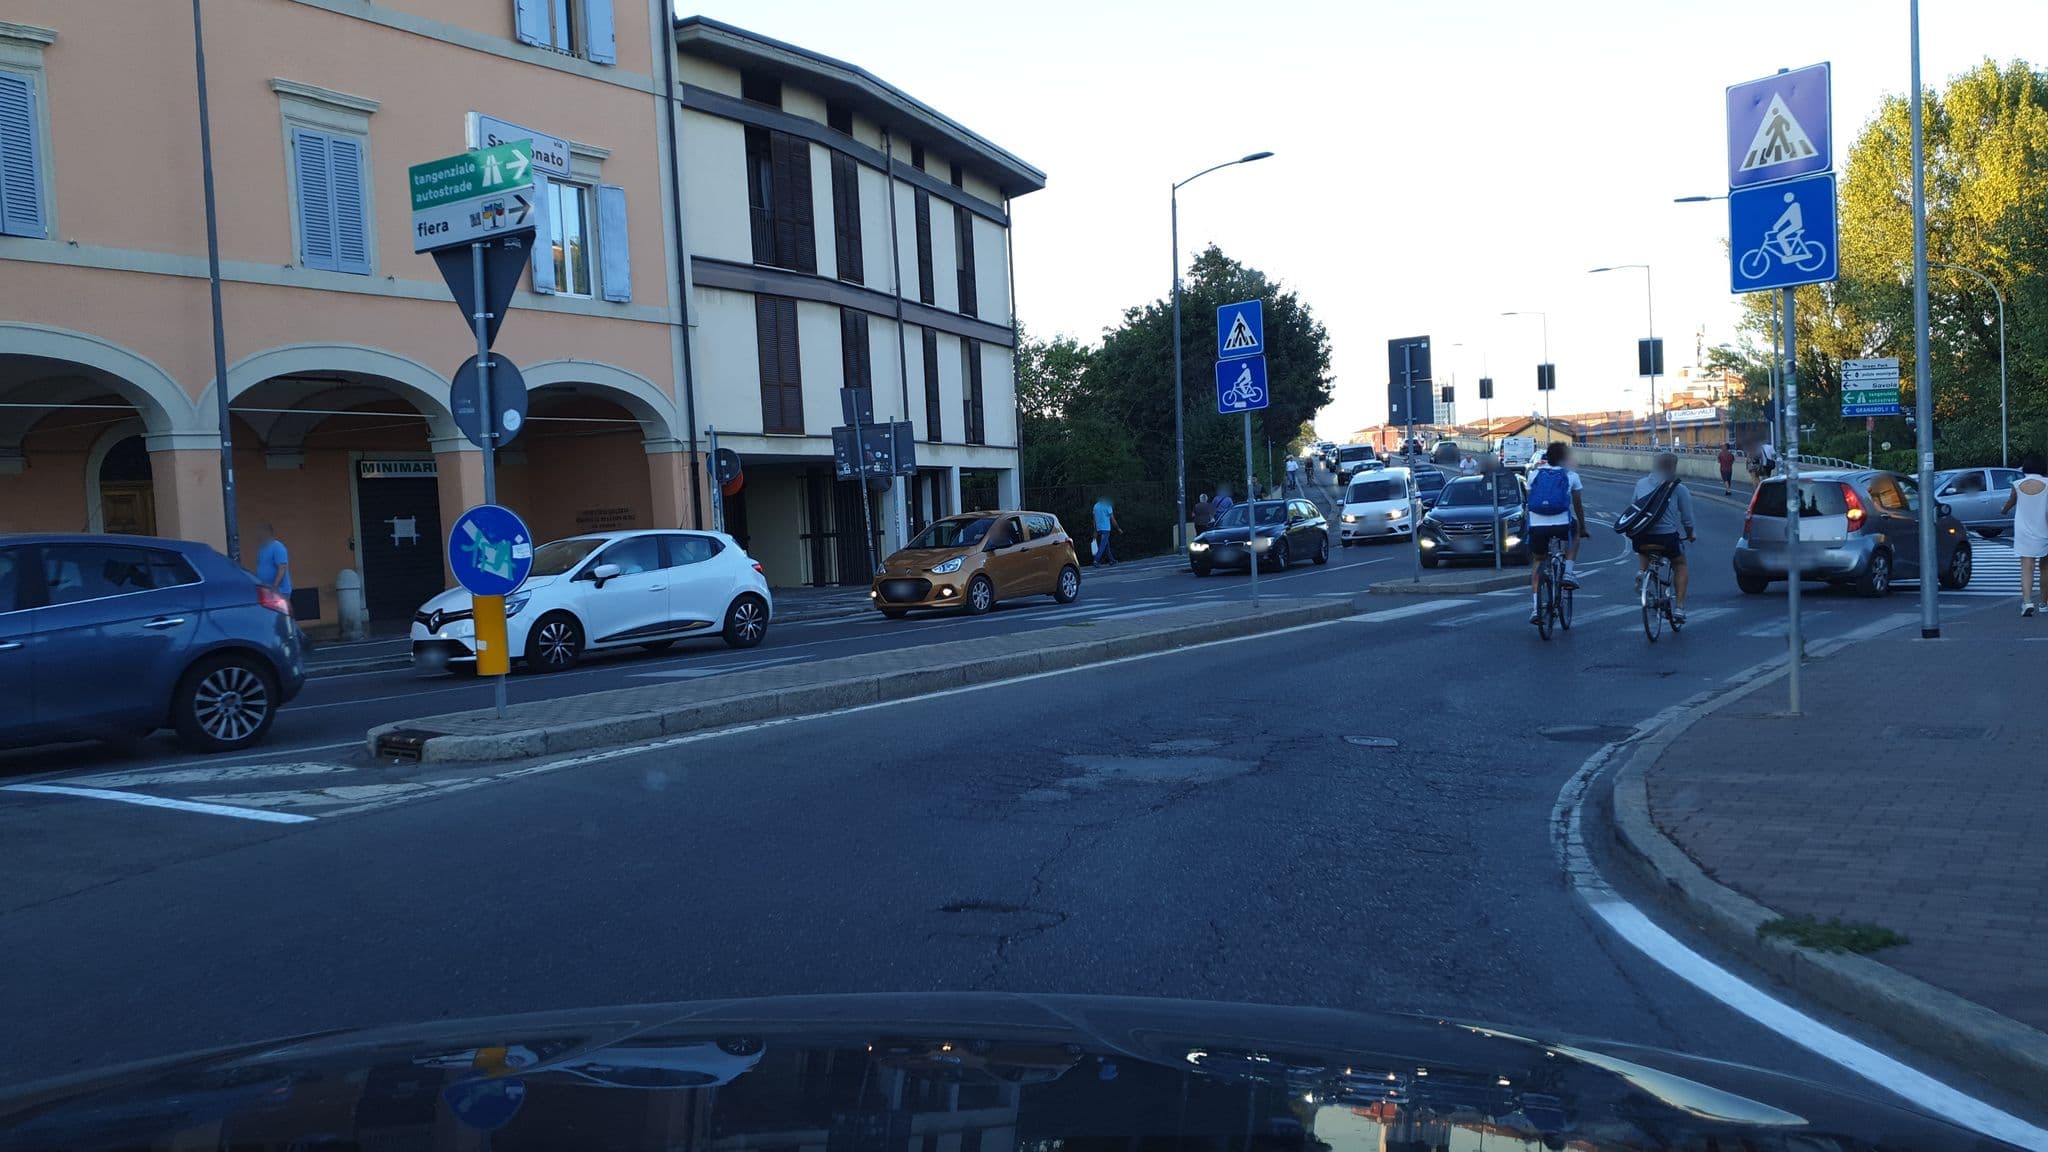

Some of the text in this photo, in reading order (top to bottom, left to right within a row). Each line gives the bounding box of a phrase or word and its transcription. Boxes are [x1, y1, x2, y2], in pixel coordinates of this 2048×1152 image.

[413, 161, 476, 185] tangenziale
[415, 181, 473, 203] autostrade
[416, 219, 449, 237] fiera
